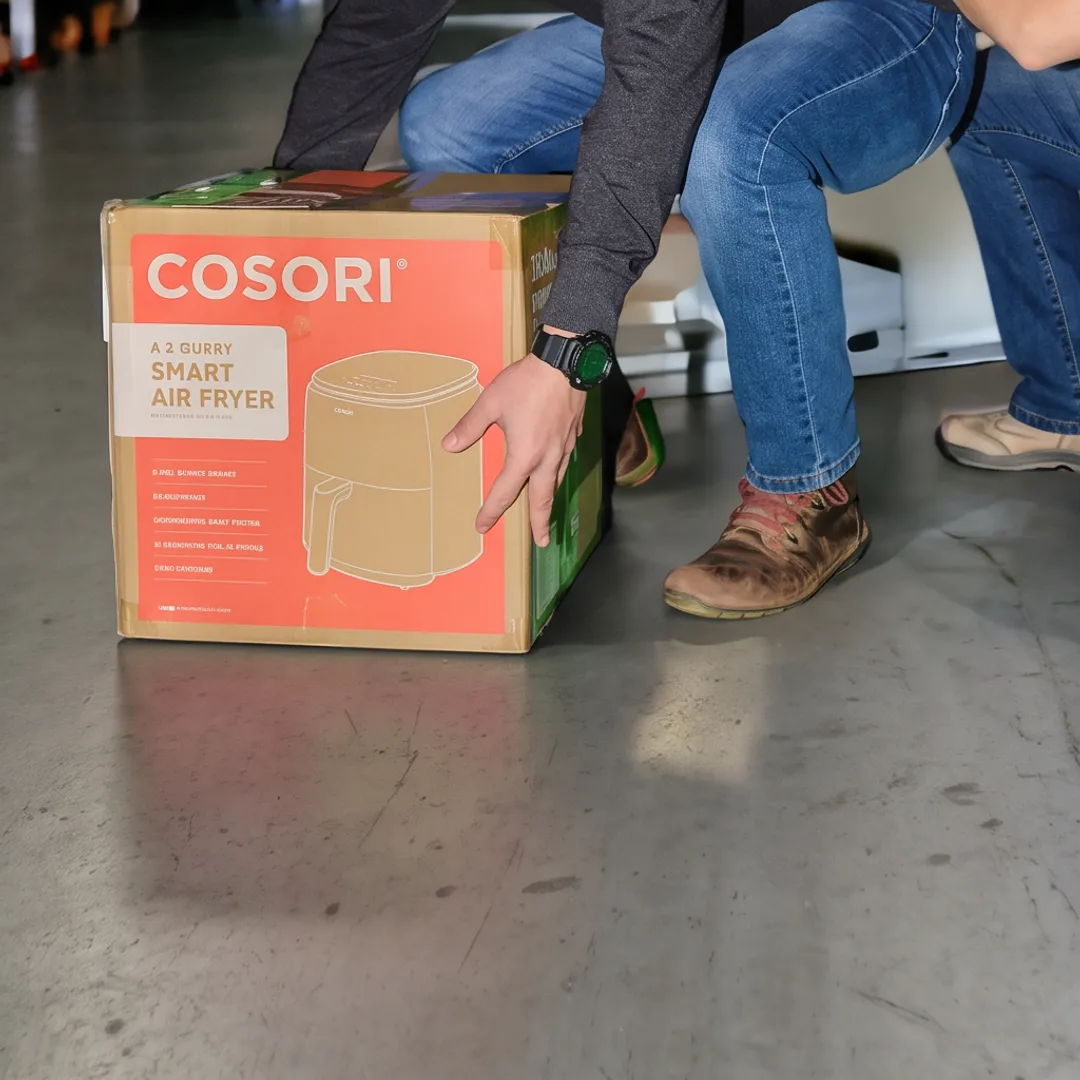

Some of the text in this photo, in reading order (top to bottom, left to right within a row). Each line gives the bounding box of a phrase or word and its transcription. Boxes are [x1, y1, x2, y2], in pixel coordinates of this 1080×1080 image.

[150, 342, 161, 354] A
[165, 342, 174, 354] 2
[151, 361, 234, 382] SMART
[151, 387, 275, 410] AIR FRYER
